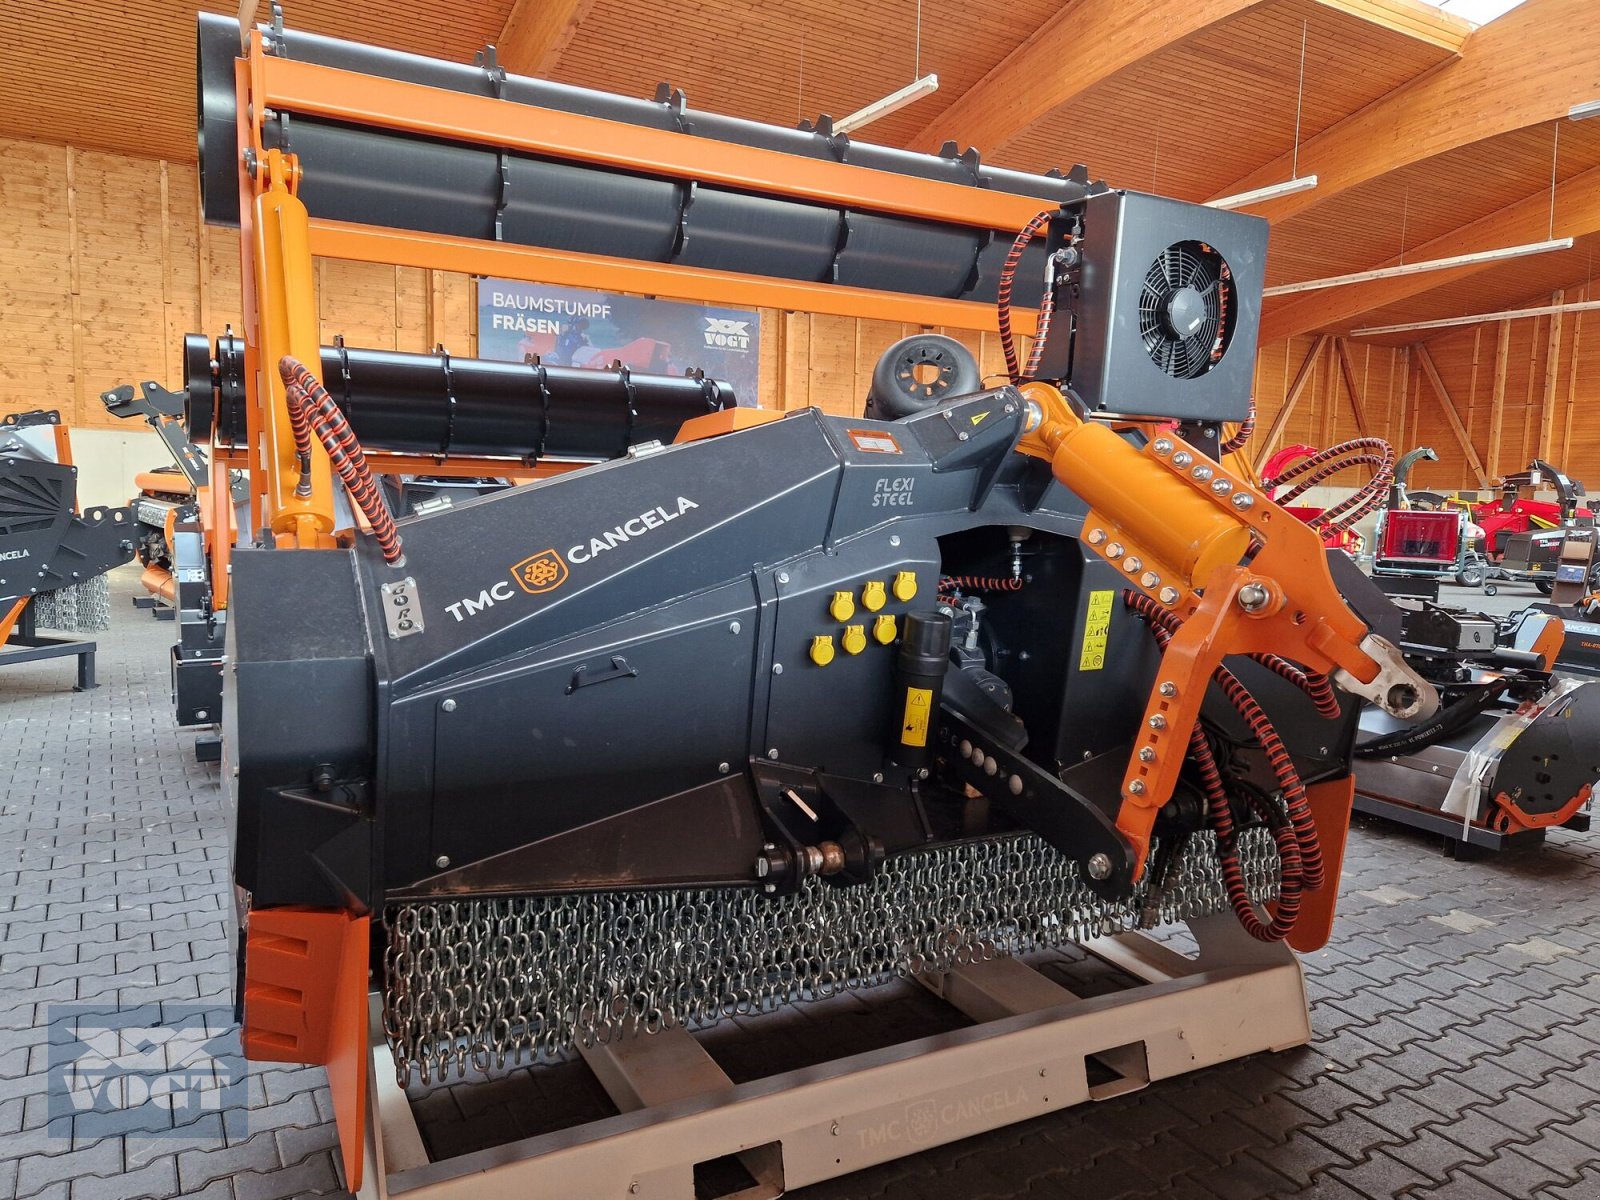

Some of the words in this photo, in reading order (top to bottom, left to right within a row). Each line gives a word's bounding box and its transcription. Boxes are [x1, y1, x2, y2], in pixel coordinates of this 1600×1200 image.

[493, 292, 611, 320] BAUMSTUMPF
[493, 313, 560, 335] FRÄSEN
[704, 332, 750, 349] VOGT
[875, 477, 914, 492] FLEXI
[872, 492, 914, 507] STEEL
[444, 580, 515, 623] TMC
[566, 496, 700, 565] CANCELA
[856, 1121, 902, 1150] TMC
[941, 1086, 1029, 1124] CANCELA
